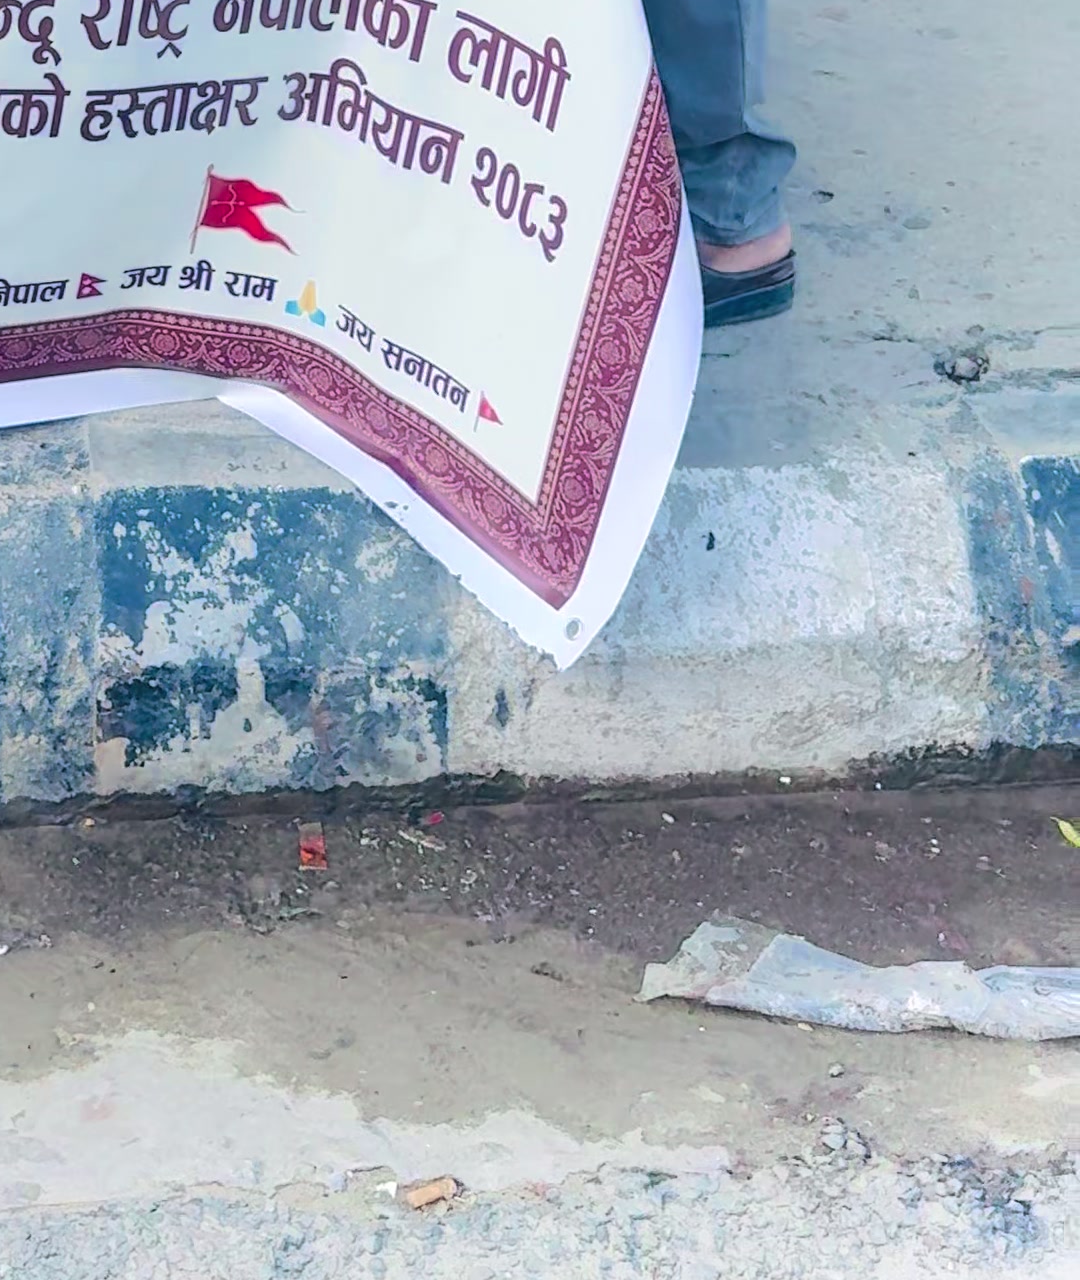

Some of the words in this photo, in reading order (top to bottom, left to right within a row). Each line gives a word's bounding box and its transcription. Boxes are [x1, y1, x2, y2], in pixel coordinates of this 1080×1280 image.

[448, 11, 571, 132] लागी
[80, 76, 268, 142] हस्ताक्षर
[277, 58, 464, 184] अभियान
[472, 148, 567, 262] २०८३
[120, 266, 172, 289] जय
[179, 260, 215, 291] श्री
[224, 272, 277, 301] राम
[336, 305, 375, 352] जय
[381, 339, 470, 412] सनातन
